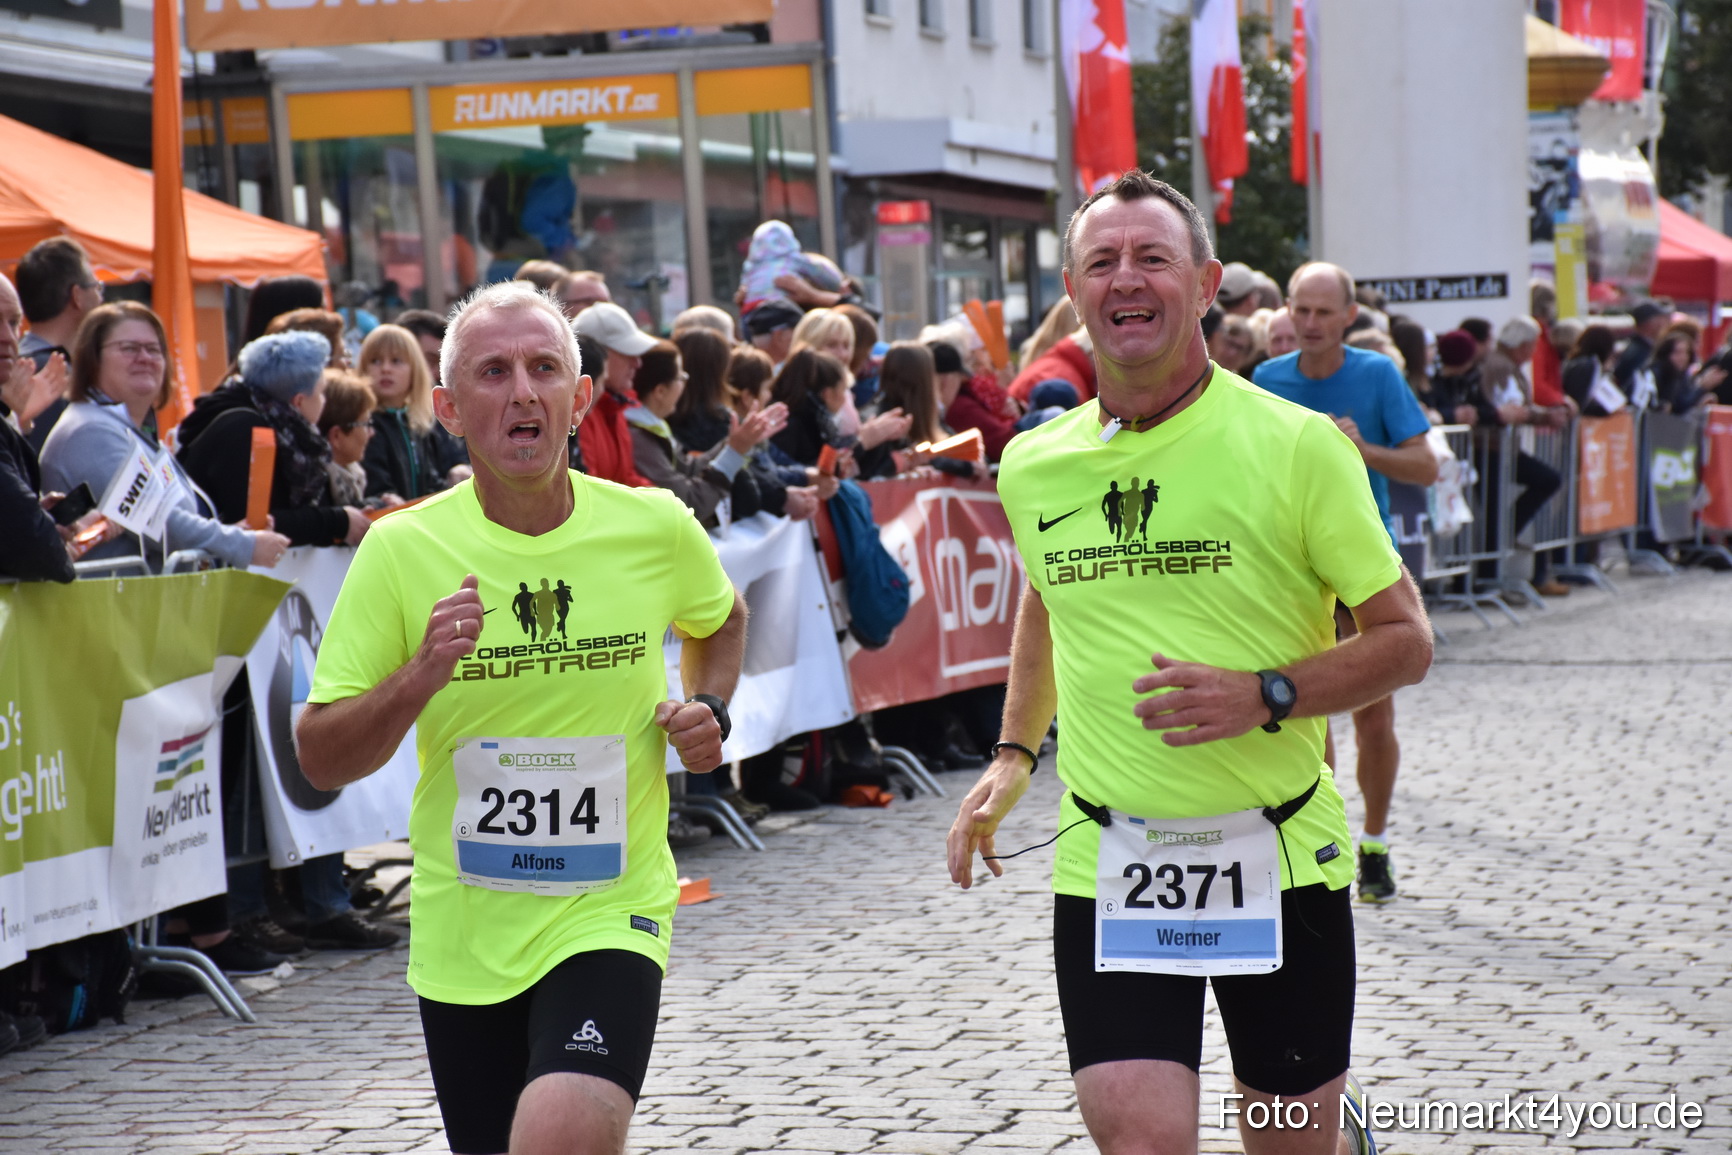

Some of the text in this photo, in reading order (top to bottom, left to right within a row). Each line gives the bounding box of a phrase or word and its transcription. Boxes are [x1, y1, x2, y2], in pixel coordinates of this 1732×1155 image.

[454, 86, 659, 122] RUNMARKT.DE
[118, 472, 148, 518] swn
[1044, 551, 1065, 566] SC
[516, 753, 576, 767] BOCK
[0, 749, 67, 841] geht!
[476, 787, 600, 836] 2314
[1163, 830, 1223, 845] BOCK
[511, 853, 565, 870] Alfons
[1122, 861, 1244, 910] 2371
[1156, 928, 1221, 946] Werner
[565, 1042, 608, 1055] odlo
